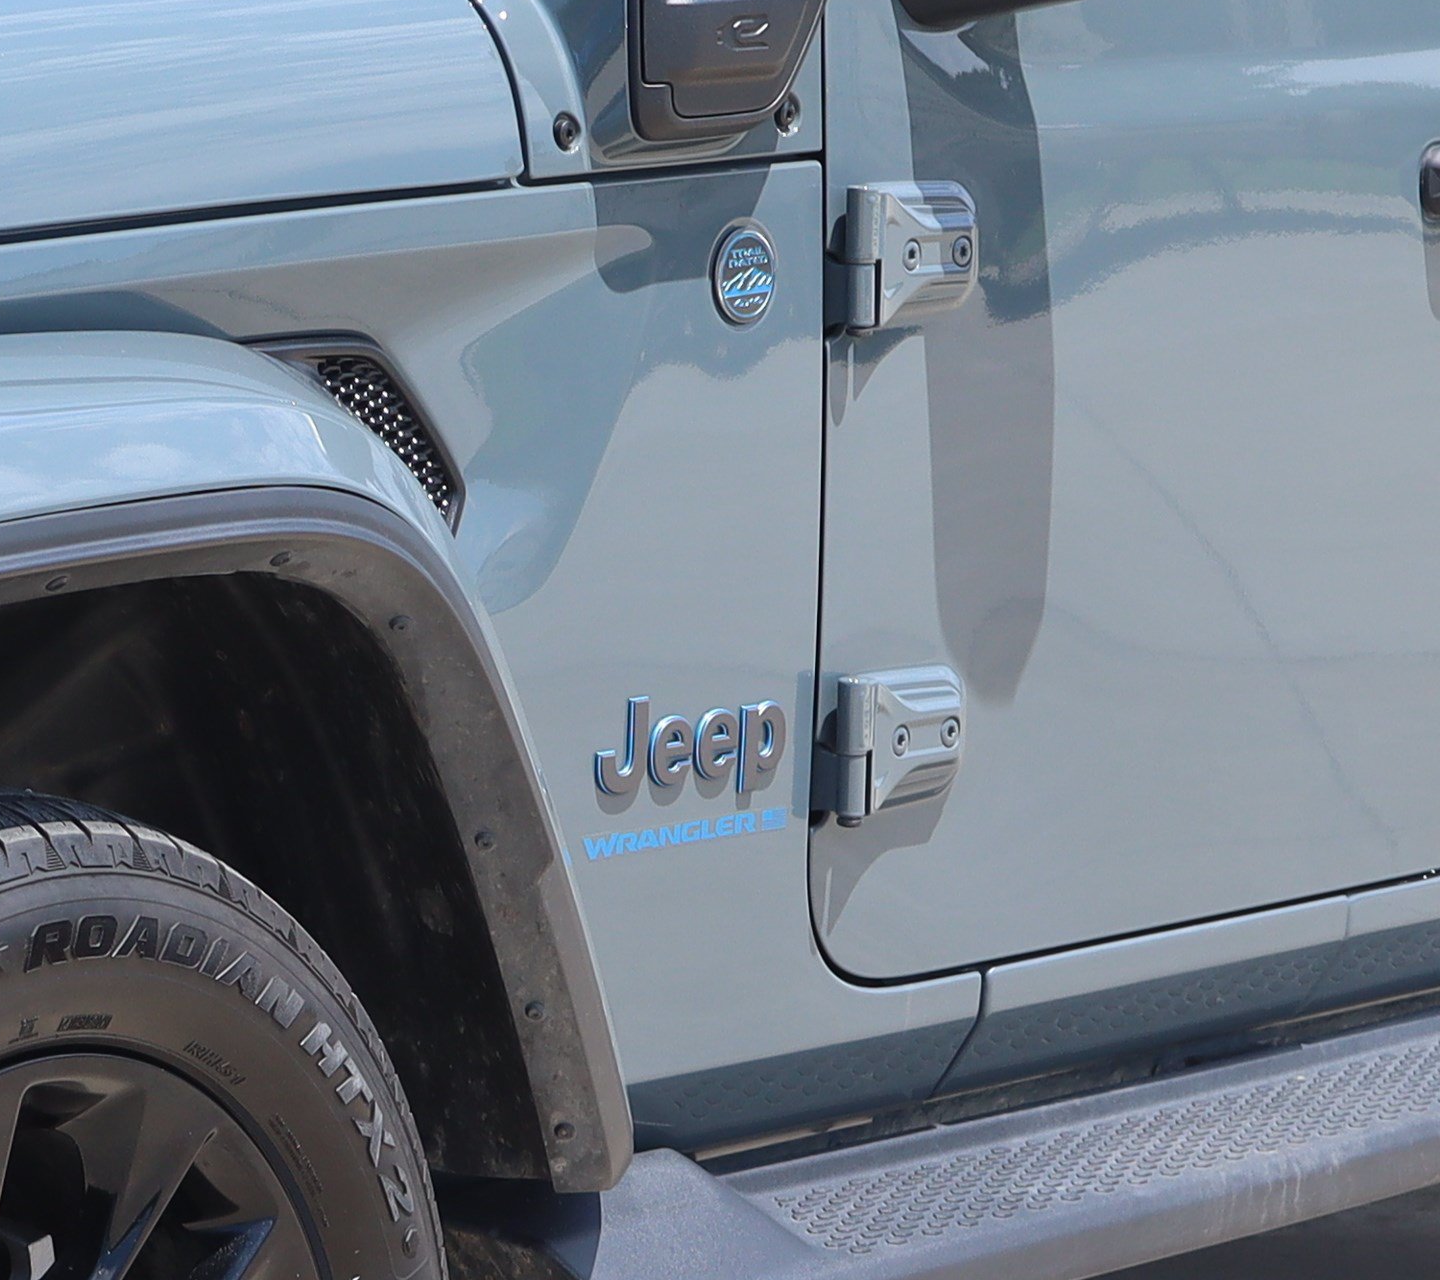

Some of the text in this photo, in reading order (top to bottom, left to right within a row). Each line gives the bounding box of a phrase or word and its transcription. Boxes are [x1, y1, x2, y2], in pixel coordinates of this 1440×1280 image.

[595, 696, 787, 796] Jeep
[583, 811, 756, 862] WRANGLER
[24, 914, 305, 1029] ROADIAN
[300, 1020, 396, 1168] HTX
[377, 1164, 414, 1222] 2
